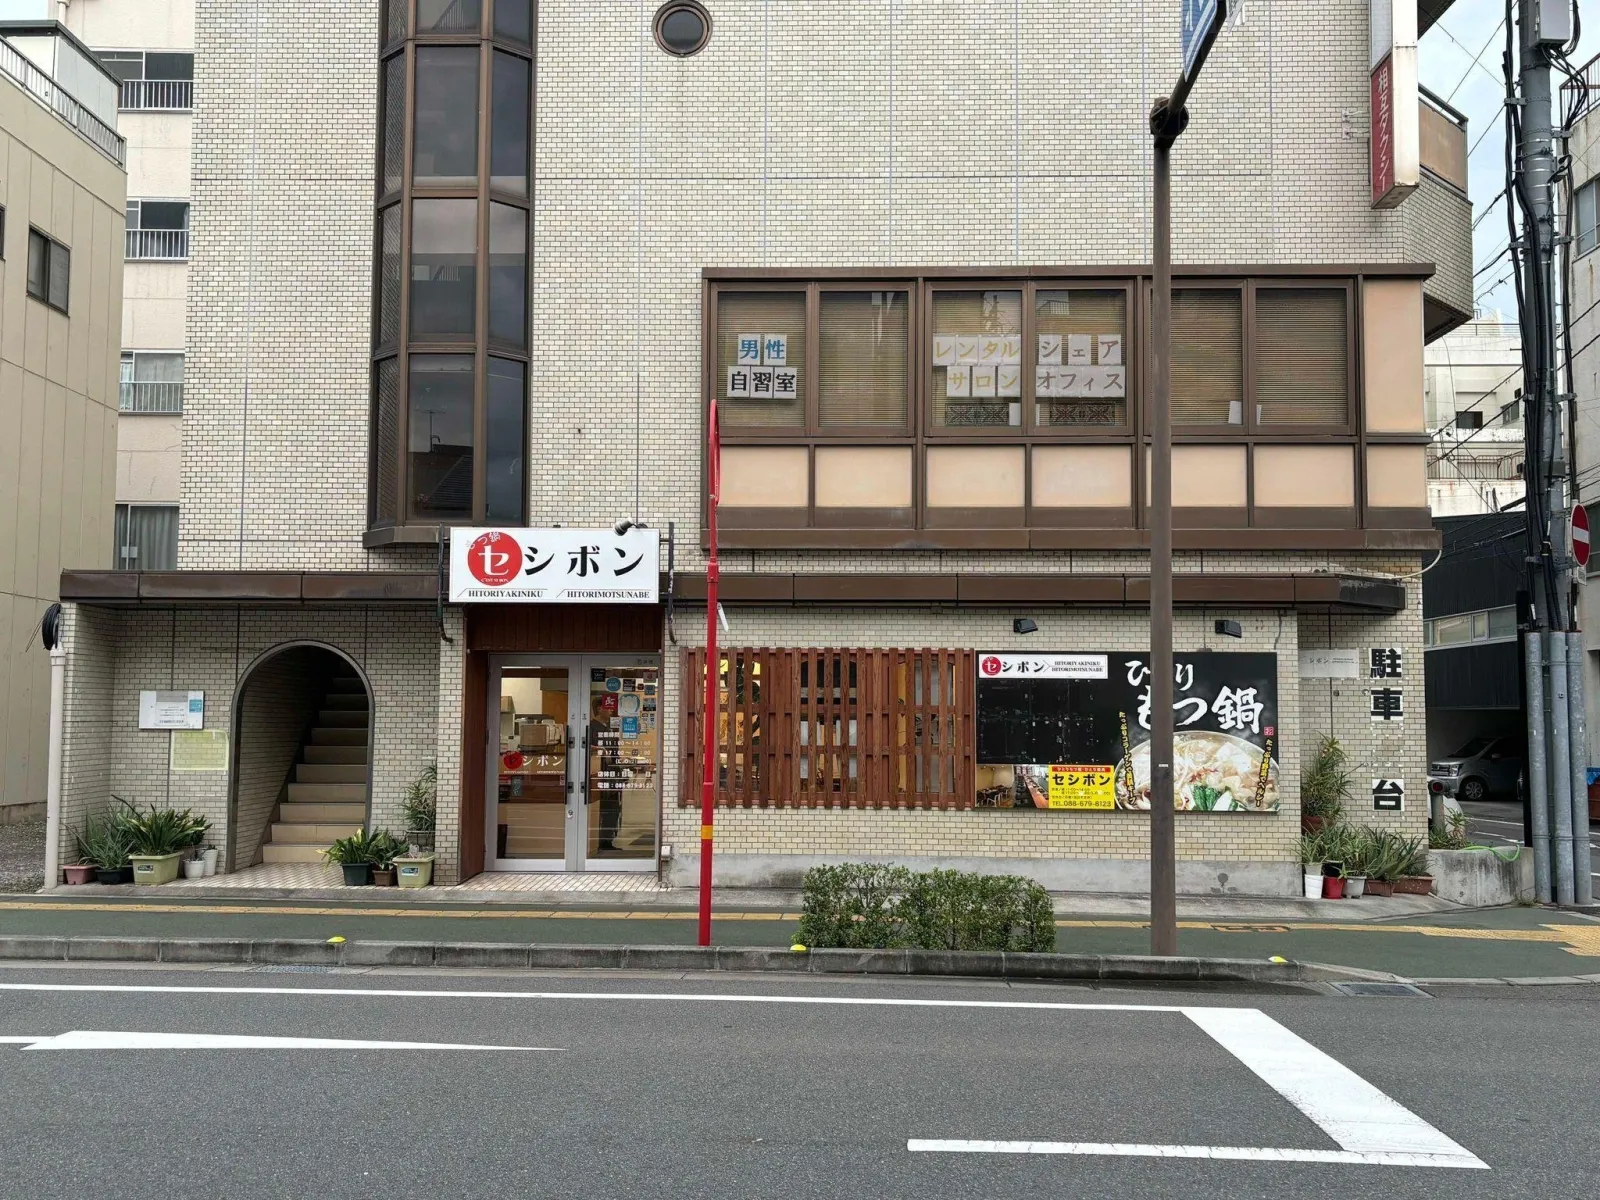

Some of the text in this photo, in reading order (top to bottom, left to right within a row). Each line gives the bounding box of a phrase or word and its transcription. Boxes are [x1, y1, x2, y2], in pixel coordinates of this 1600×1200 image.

[1377, 66, 1390, 192] 相互タクシー
[738, 338, 787, 361] 男性
[934, 339, 1020, 358] レンタル
[1040, 339, 1121, 359] シェア
[730, 371, 797, 393] 自習室
[947, 372, 1018, 390] サロン
[1036, 371, 1124, 391] オフィス
[477, 544, 644, 577] セシボン
[468, 590, 544, 598] HITORIYAKINIKU
[566, 590, 650, 599] HITORIMOTSUNABE
[985, 659, 1045, 673] セシボン
[1124, 659, 1194, 691] ひり
[1369, 648, 1404, 811] 駐車 台
[1052, 773, 1111, 787] セシボン
